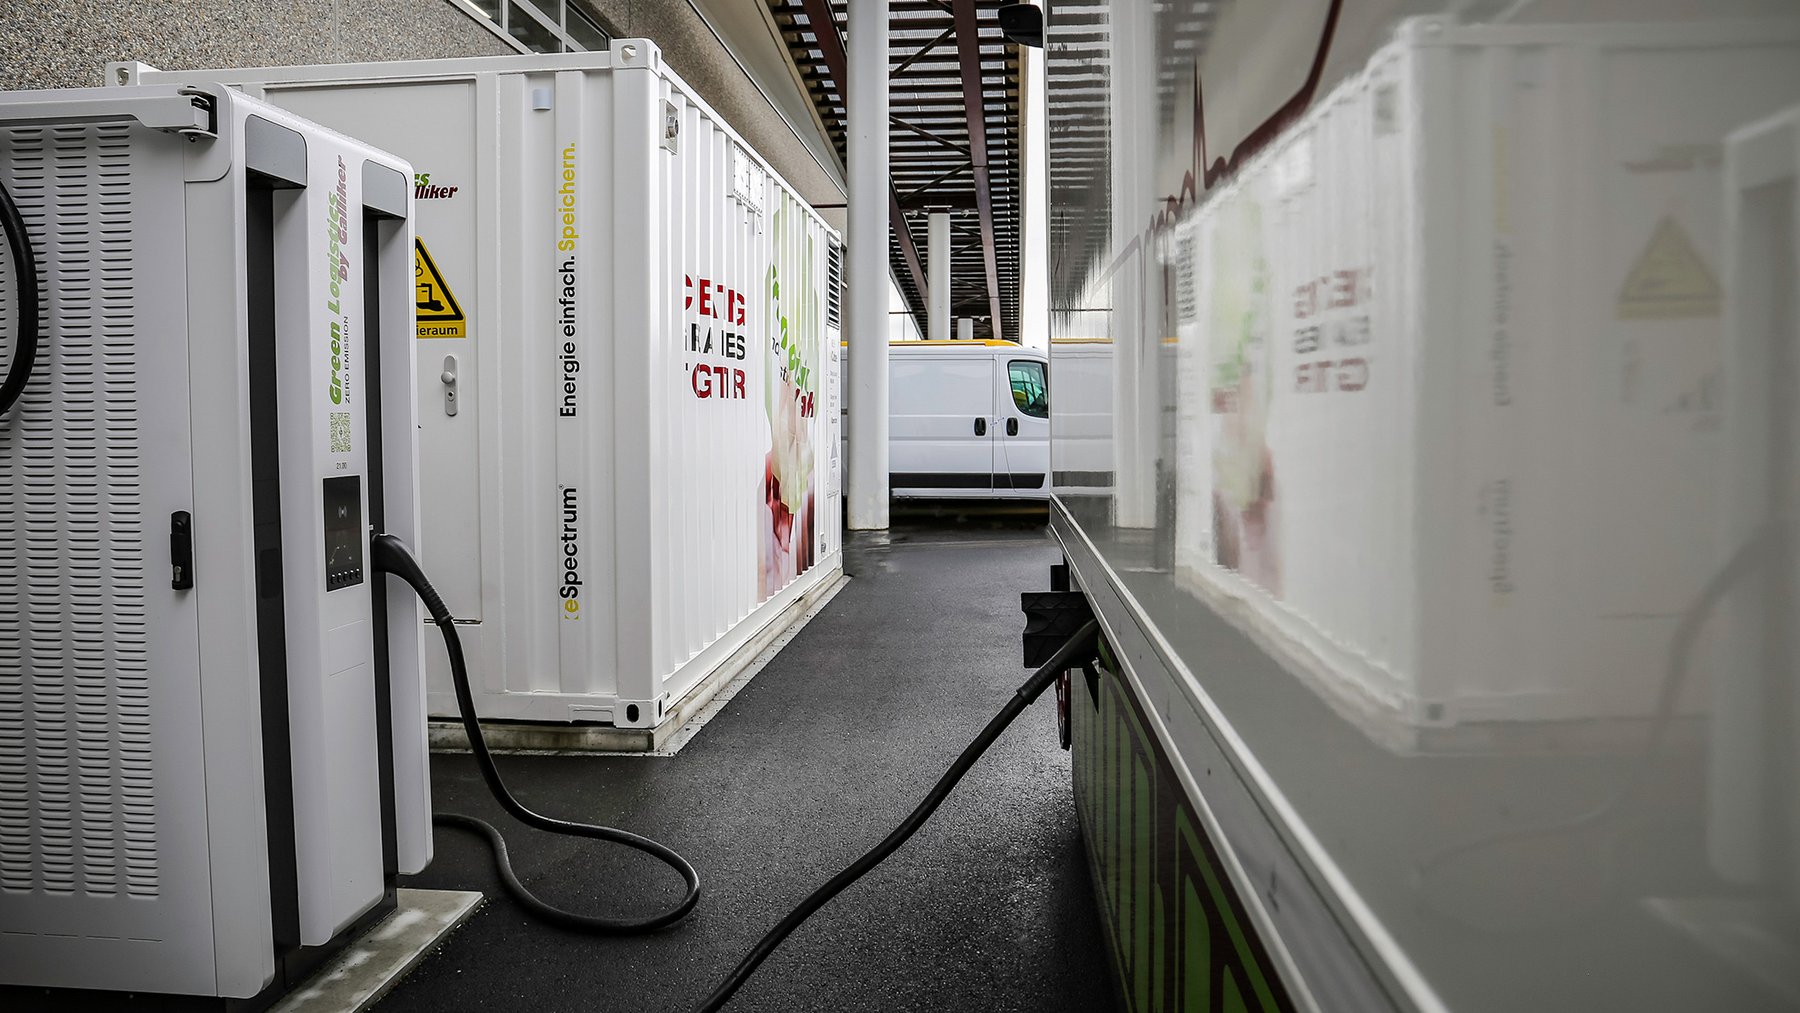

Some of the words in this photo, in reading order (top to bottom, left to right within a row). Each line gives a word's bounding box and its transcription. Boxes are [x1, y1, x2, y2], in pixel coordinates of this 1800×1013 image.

[337, 154, 348, 245] Galliker
[557, 142, 579, 252] Speichern.
[327, 191, 343, 315] Logistics
[338, 251, 350, 282] by
[558, 255, 576, 337] einfach.
[329, 321, 342, 405] Green
[558, 342, 580, 418] Energie
